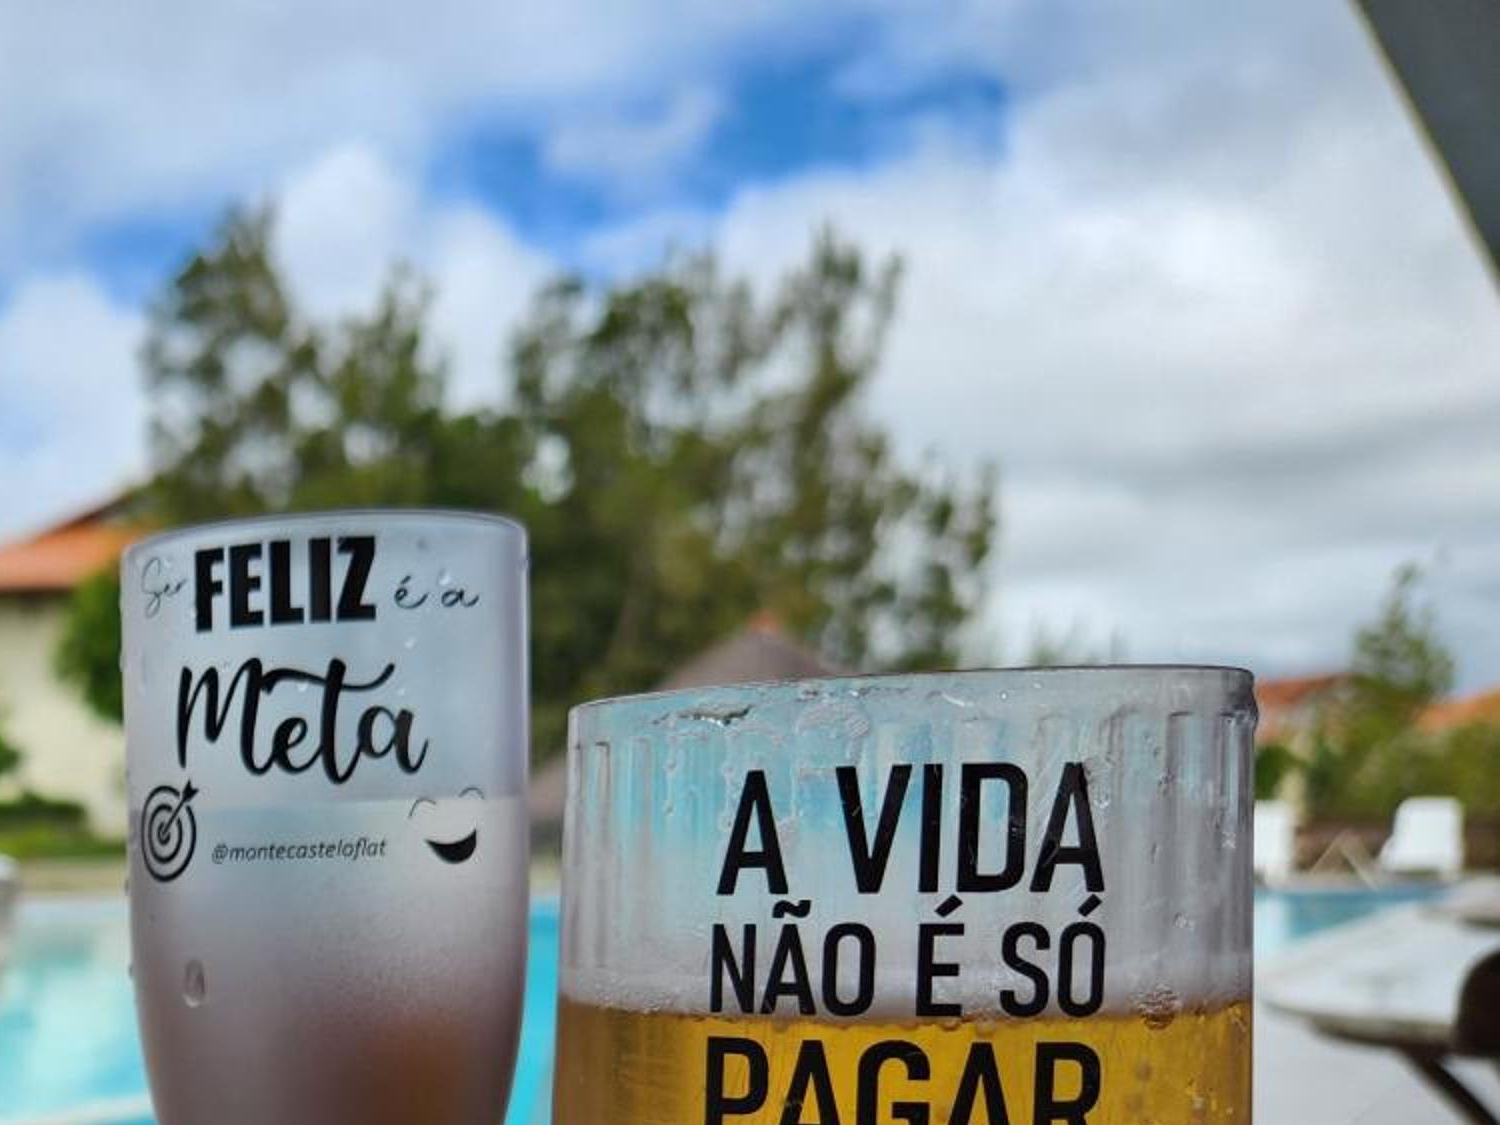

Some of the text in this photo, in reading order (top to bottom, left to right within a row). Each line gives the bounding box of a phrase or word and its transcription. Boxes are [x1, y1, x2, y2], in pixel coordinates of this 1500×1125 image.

[195, 536, 376, 633] FELIZ
[394, 575, 429, 609] é
[441, 588, 479, 608] a
[177, 657, 428, 785] Meta
[211, 838, 387, 864] @montecasteloflat
[716, 762, 1106, 897] A VIDA
[709, 895, 1107, 1018] NÃO É SÓ
